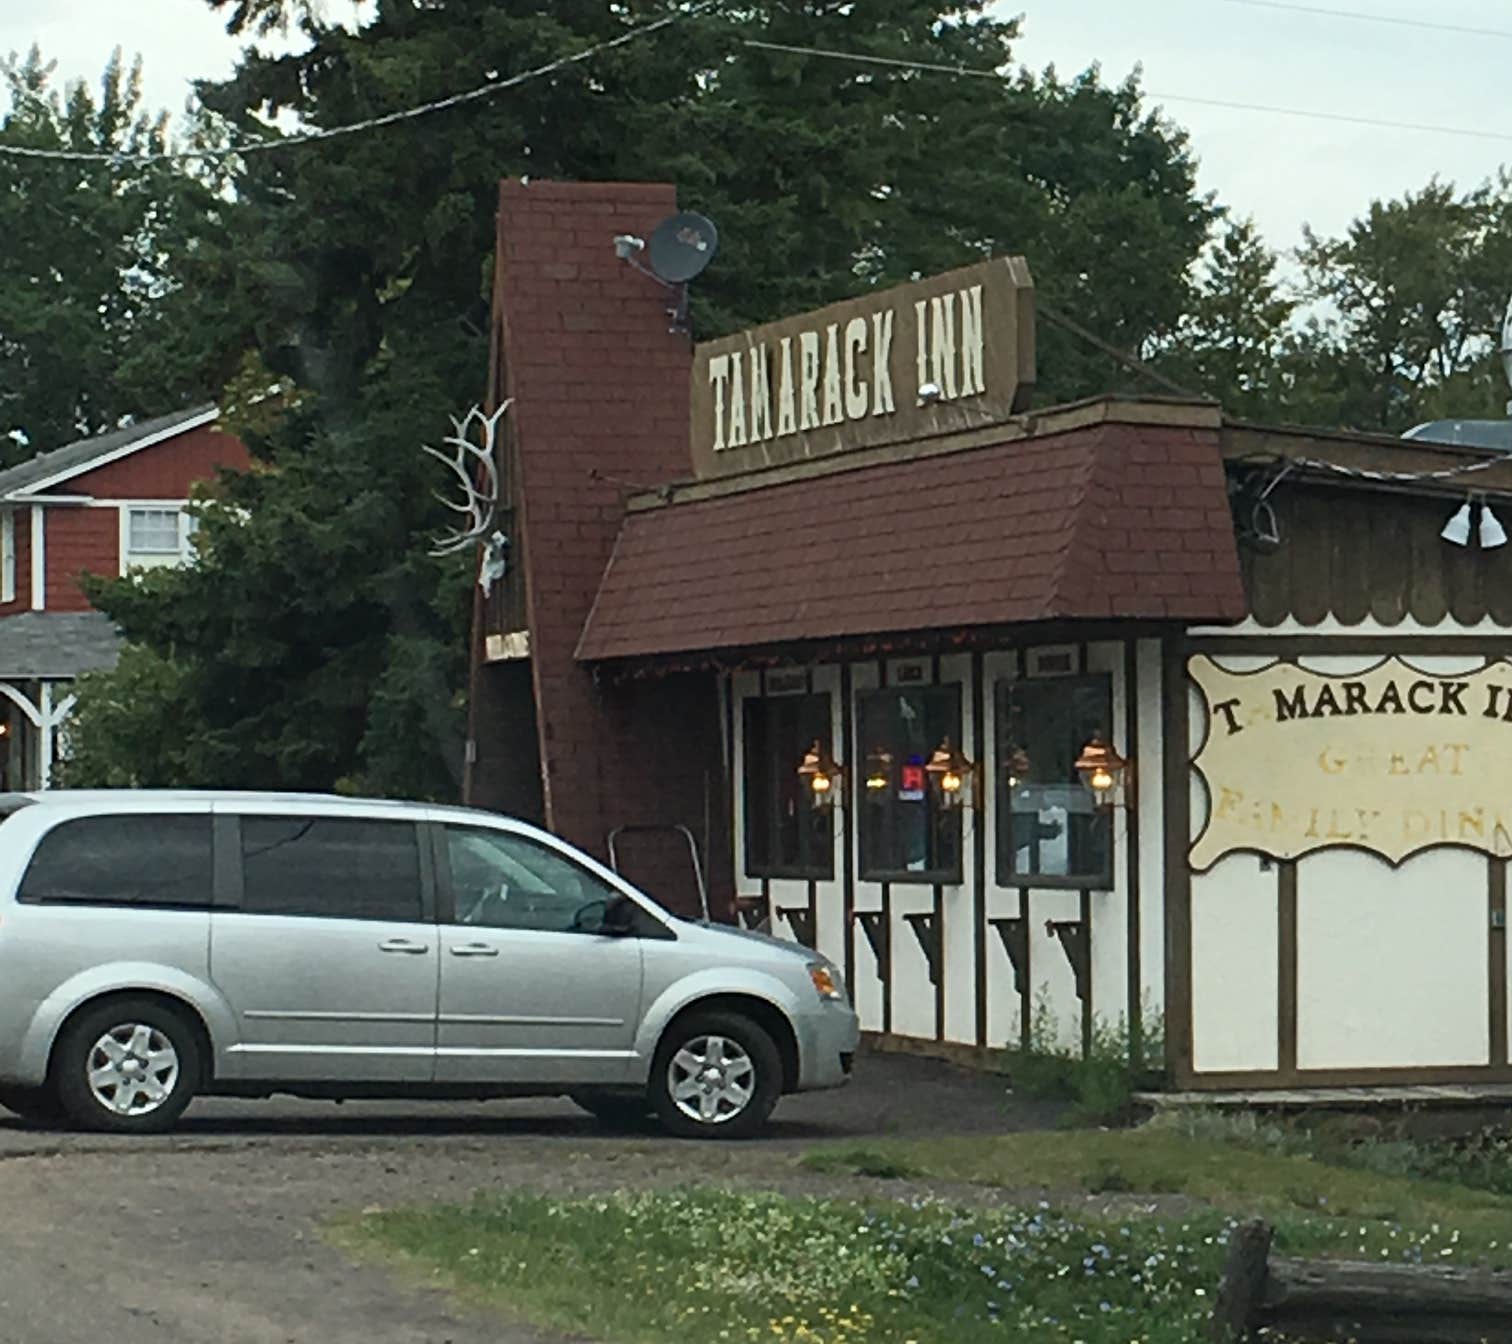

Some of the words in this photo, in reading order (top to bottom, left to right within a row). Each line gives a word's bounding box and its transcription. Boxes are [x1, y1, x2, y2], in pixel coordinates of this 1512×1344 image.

[708, 309, 896, 452] TAMARACK
[914, 284, 986, 408] INN
[1213, 680, 1470, 736] TMARACK
